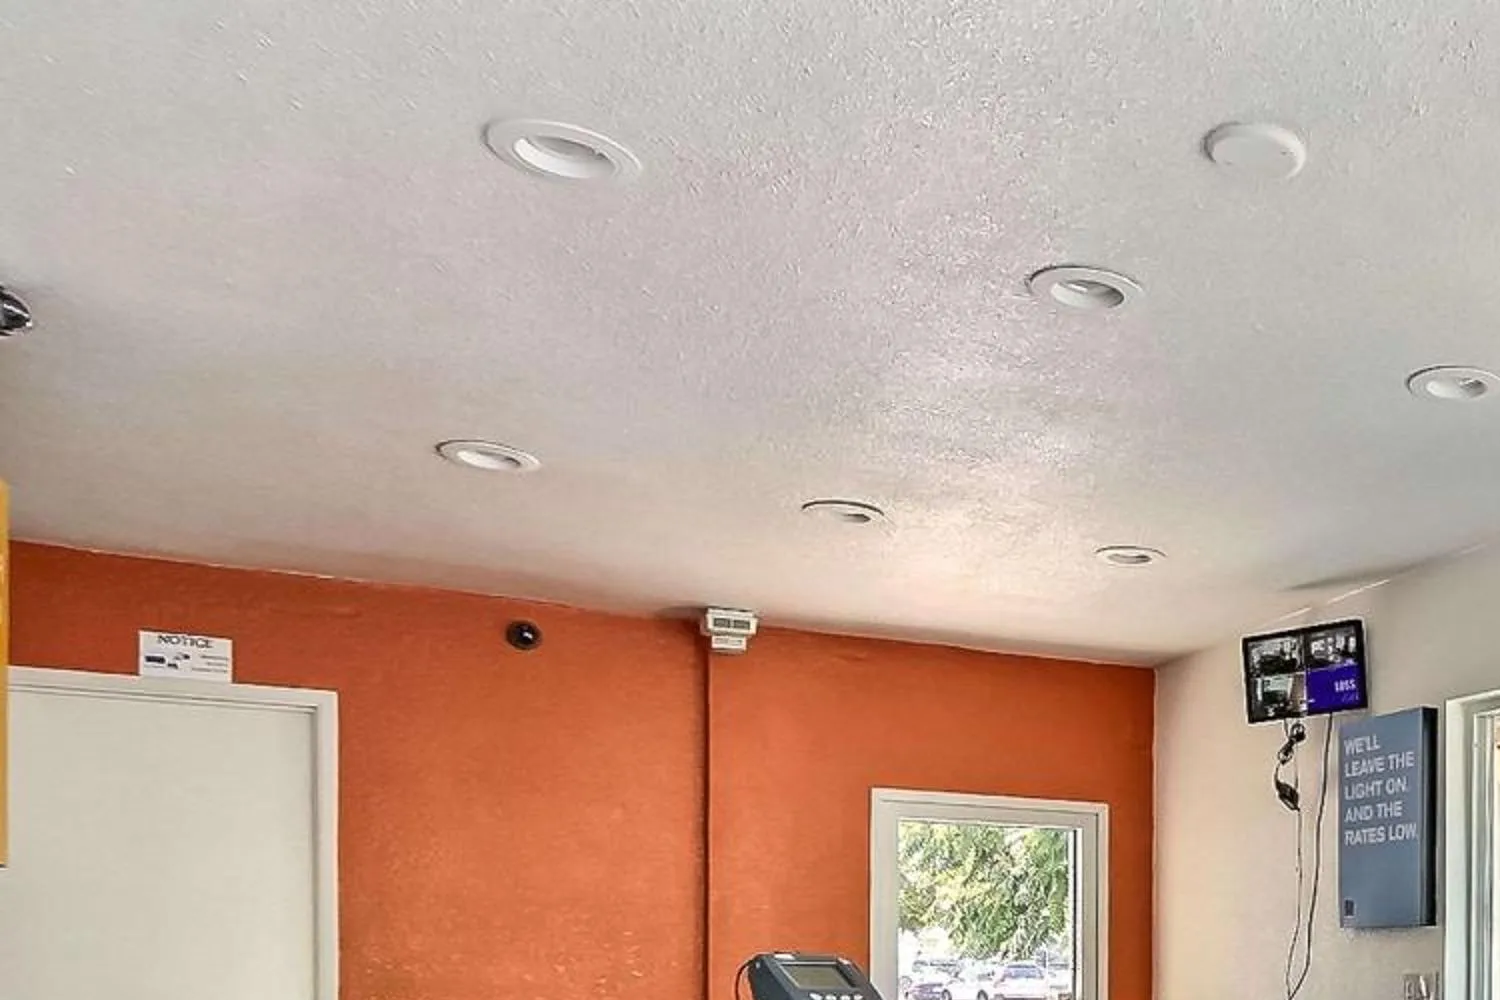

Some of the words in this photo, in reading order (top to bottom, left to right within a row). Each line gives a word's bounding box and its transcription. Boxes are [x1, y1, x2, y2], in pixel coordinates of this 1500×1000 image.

[157, 635, 213, 648] NOTICE
[1343, 735, 1380, 756] WE'LL
[1344, 756, 1385, 777] LEAVE
[1387, 751, 1415, 770] THE
[1344, 780, 1384, 800] LIGHT
[1385, 776, 1407, 795] ON
[1344, 804, 1373, 822] AND
[1376, 801, 1403, 819] THE
[1344, 826, 1385, 846] RATES
